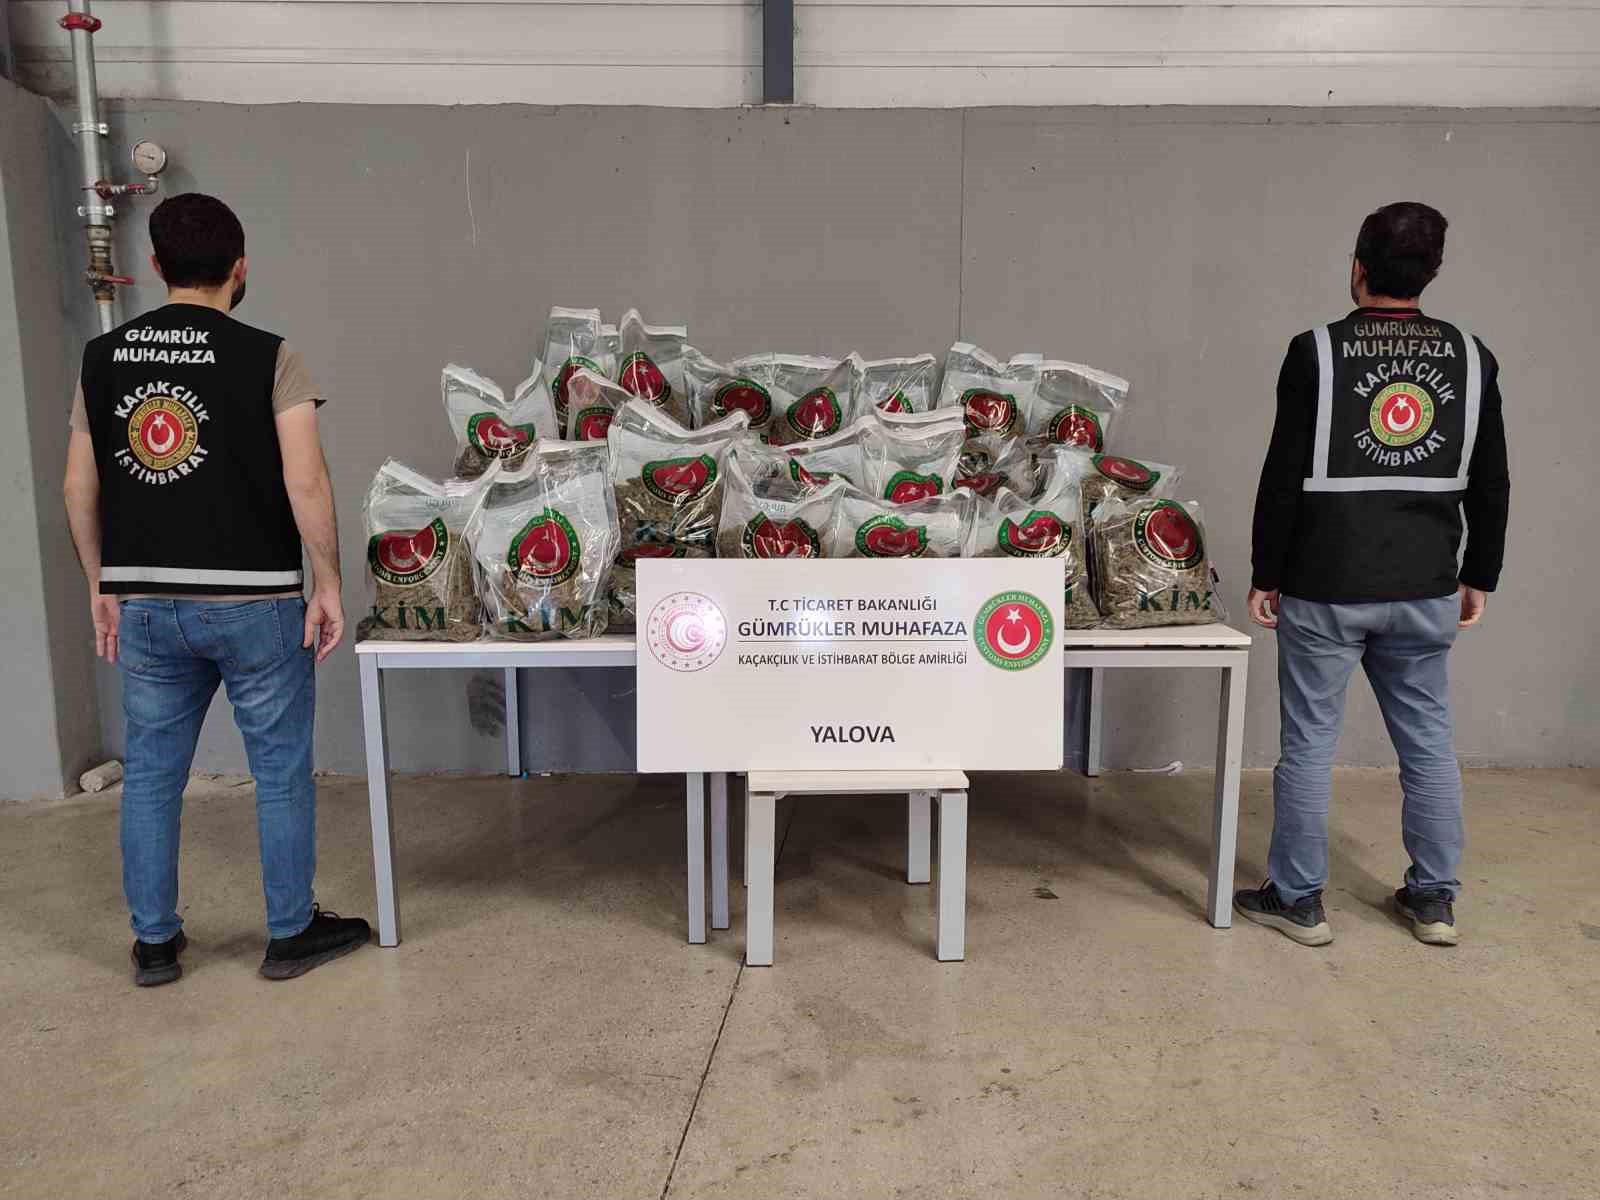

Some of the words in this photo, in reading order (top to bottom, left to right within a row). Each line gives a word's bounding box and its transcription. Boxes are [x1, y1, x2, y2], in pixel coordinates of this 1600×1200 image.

[124, 325, 210, 345] GÜMRÜK
[112, 347, 216, 365] MUHAFAZA
[1342, 339, 1457, 358] MUHAFAZA
[1353, 359, 1456, 405] KAÇAKÇILIK
[114, 380, 210, 424] KAÇAKÇILIK
[1353, 428, 1447, 467] İSTİHBARAT
[113, 443, 209, 485] İSTİHBARAT
[793, 596, 854, 611] TİCARET
[858, 596, 937, 611] BAKANLIĞI
[738, 617, 857, 637] GÜMRÜKLER
[861, 621, 967, 636] MUHAFAZA
[738, 654, 799, 668] KAÇAKÇILIK
[801, 654, 815, 665] VE
[818, 651, 879, 665] İSTİHBARAT
[881, 652, 916, 665] BÖLGE
[918, 651, 967, 665] AMİRLİĞİ
[810, 725, 896, 744] YALOVA
